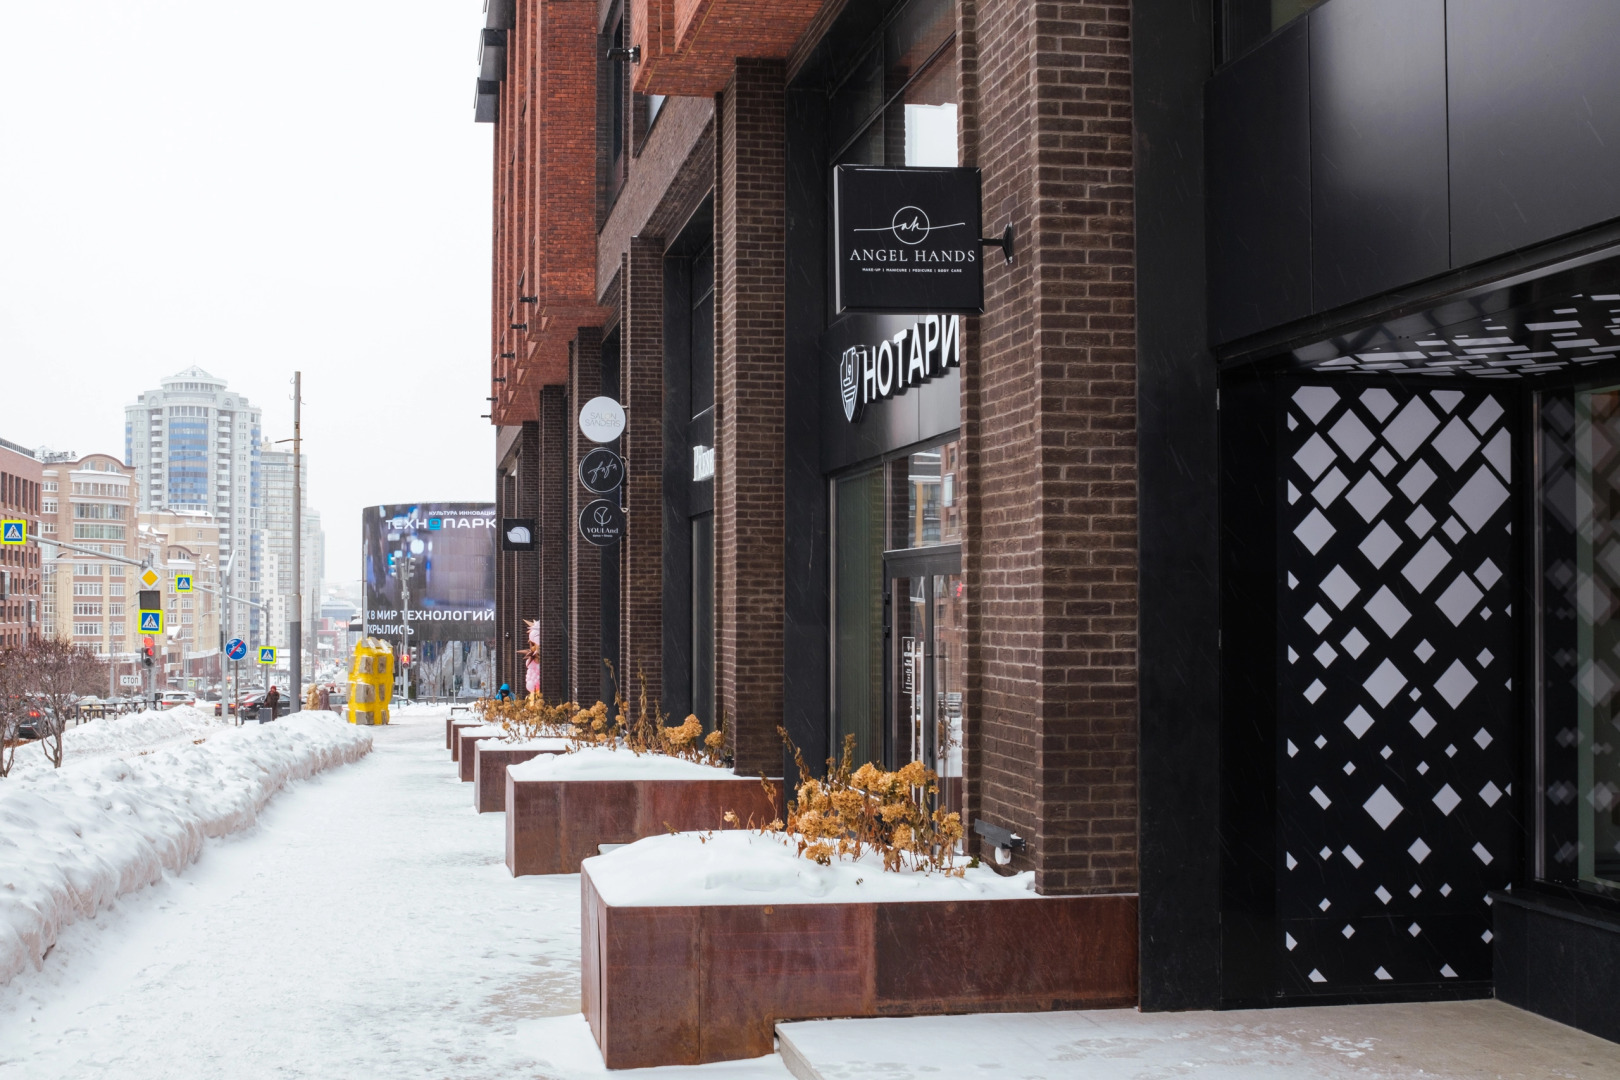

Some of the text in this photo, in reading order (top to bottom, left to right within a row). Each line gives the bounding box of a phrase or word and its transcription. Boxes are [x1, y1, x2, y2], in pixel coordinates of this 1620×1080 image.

[849, 249, 975, 262] ANGEL HANDS
[590, 411, 617, 420] SALON
[584, 418, 621, 428] SANDERS
[385, 518, 497, 531] ТЕХНОПАРК
[376, 609, 398, 620] МИР
[399, 608, 495, 621] ТЕХНОЛОГИЙ
[122, 676, 139, 684] СТОП
